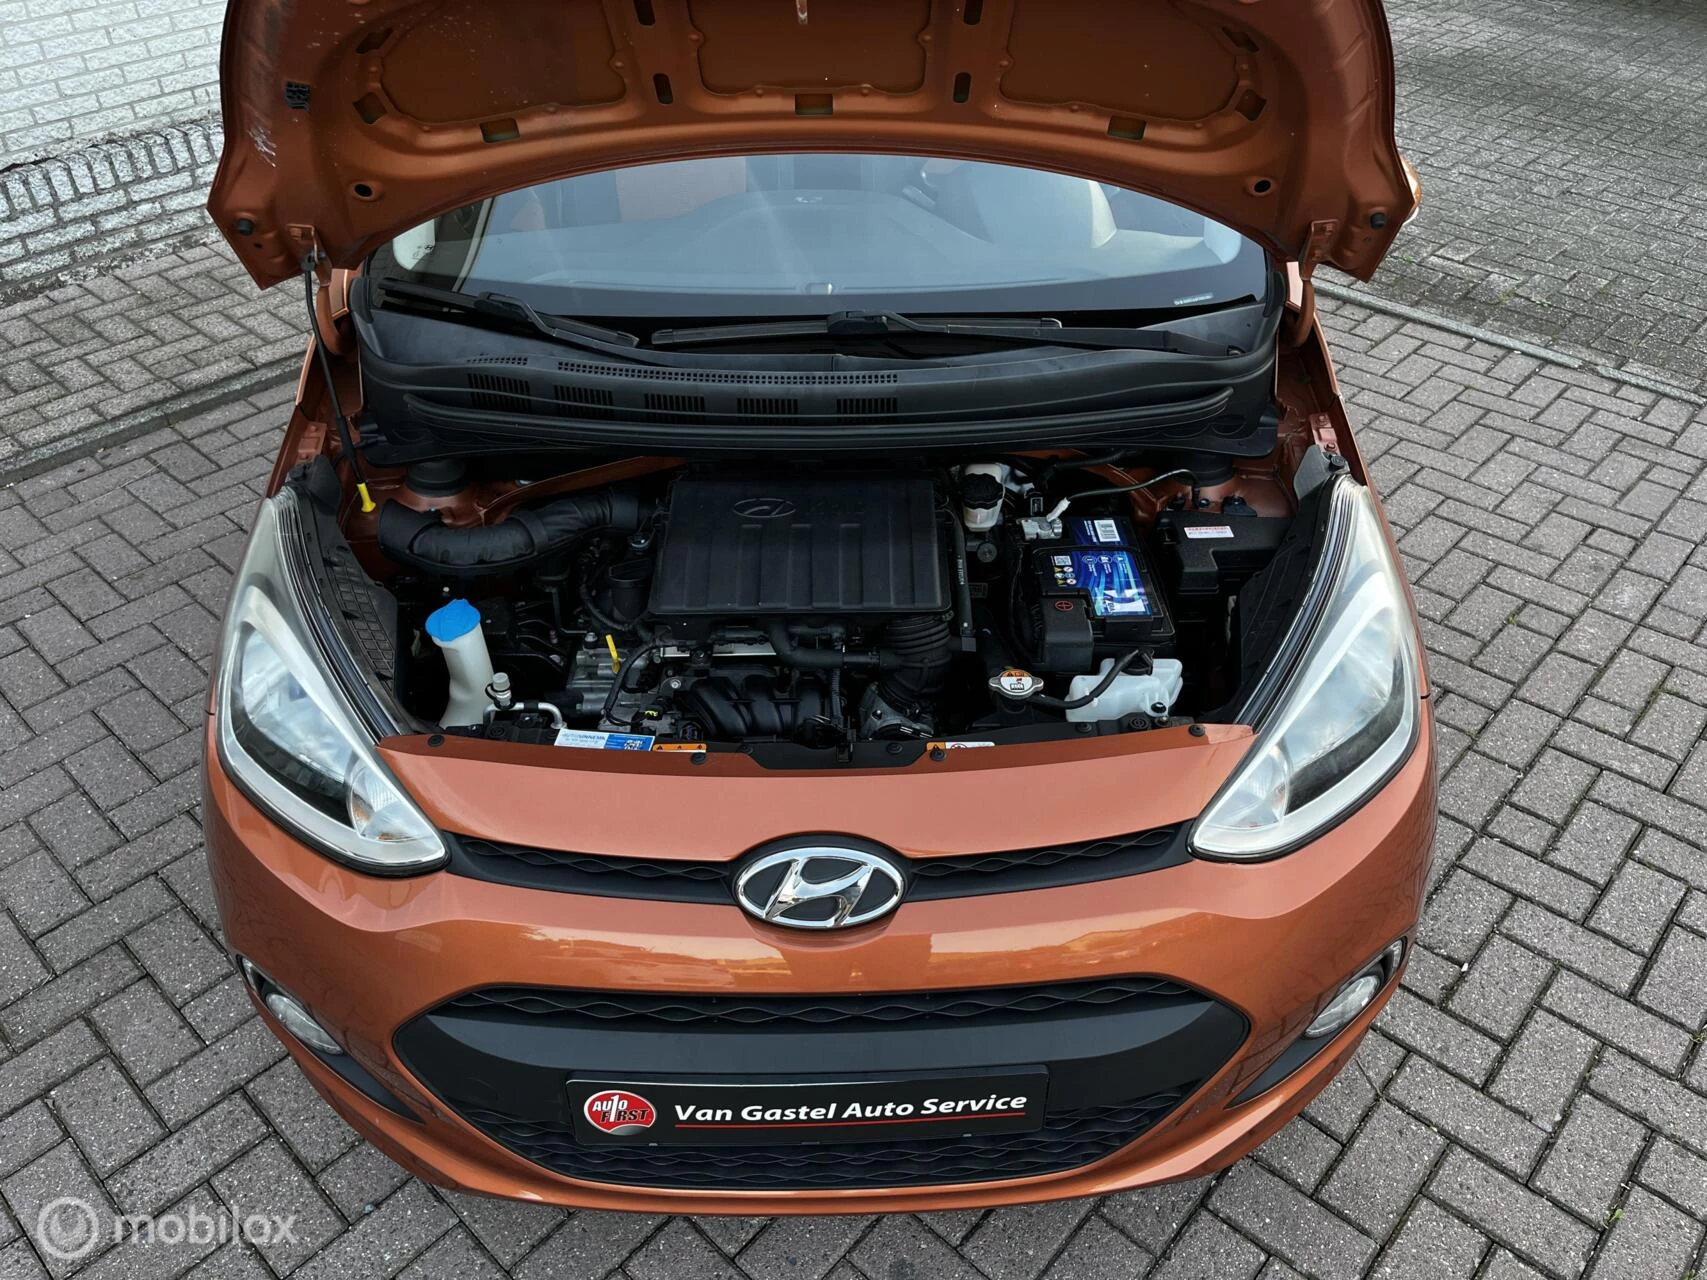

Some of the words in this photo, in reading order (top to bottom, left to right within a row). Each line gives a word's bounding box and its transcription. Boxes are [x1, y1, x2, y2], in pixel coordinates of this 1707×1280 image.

[600, 1108, 649, 1123] FIRST
[675, 1104, 732, 1121] Van
[741, 1102, 836, 1121] Gastel
[841, 1098, 915, 1119] Auto
[920, 1094, 1028, 1115] Service
